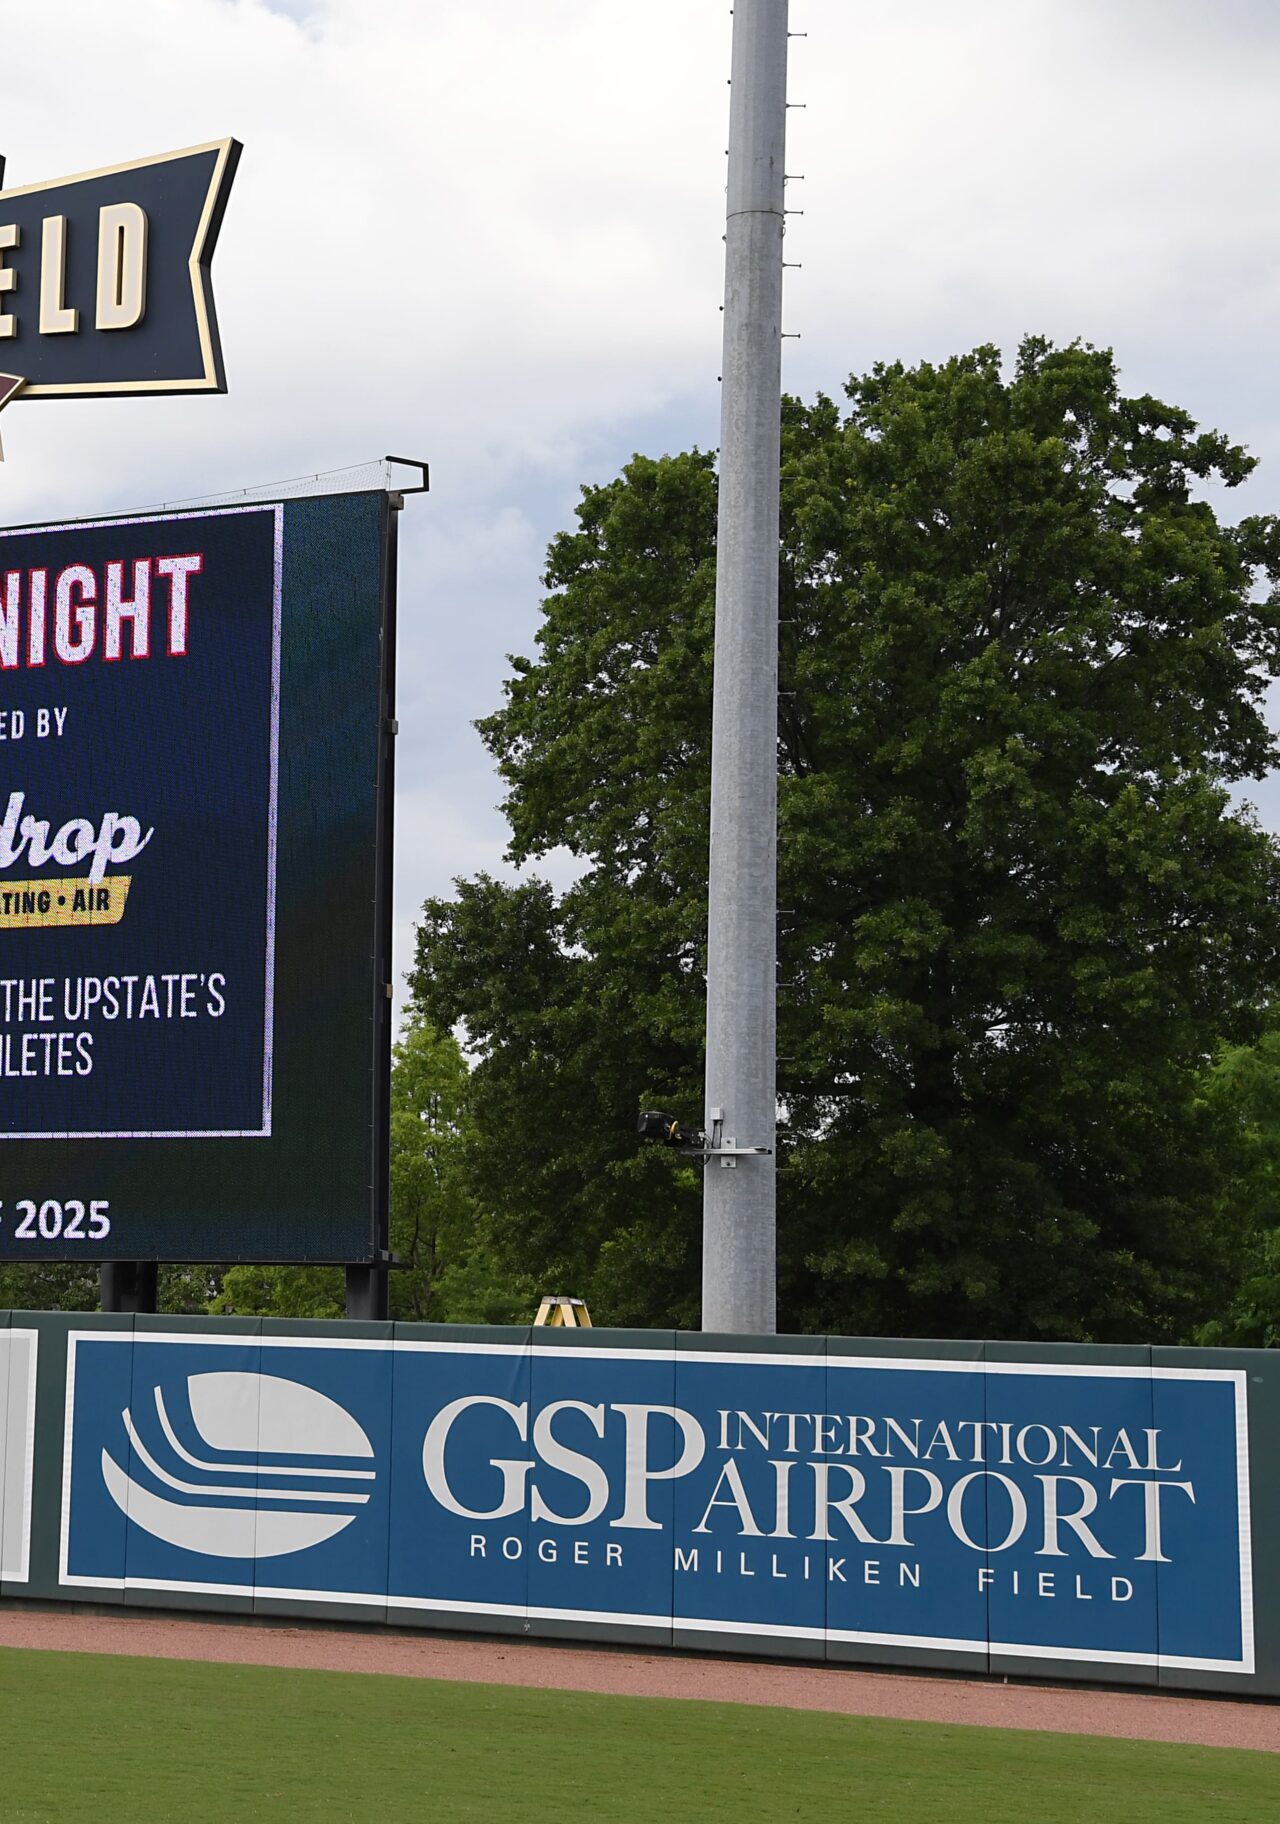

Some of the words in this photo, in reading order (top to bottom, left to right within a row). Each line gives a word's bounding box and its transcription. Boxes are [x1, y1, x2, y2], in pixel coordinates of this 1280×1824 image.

[37, 707, 68, 738] BY
[72, 887, 111, 913] AIR
[0, 978, 55, 1022] THE
[64, 972, 226, 1021] UPSTATE'S
[14, 1200, 111, 1240] 2025
[421, 1394, 706, 1532] GSP
[716, 1409, 1183, 1473] INTERNATIONAL
[691, 1456, 1197, 1563] AIRPORT
[470, 1533, 623, 1567] ROGER
[675, 1547, 920, 1588] MILLIKEN
[978, 1568, 1134, 1602] FIELD
